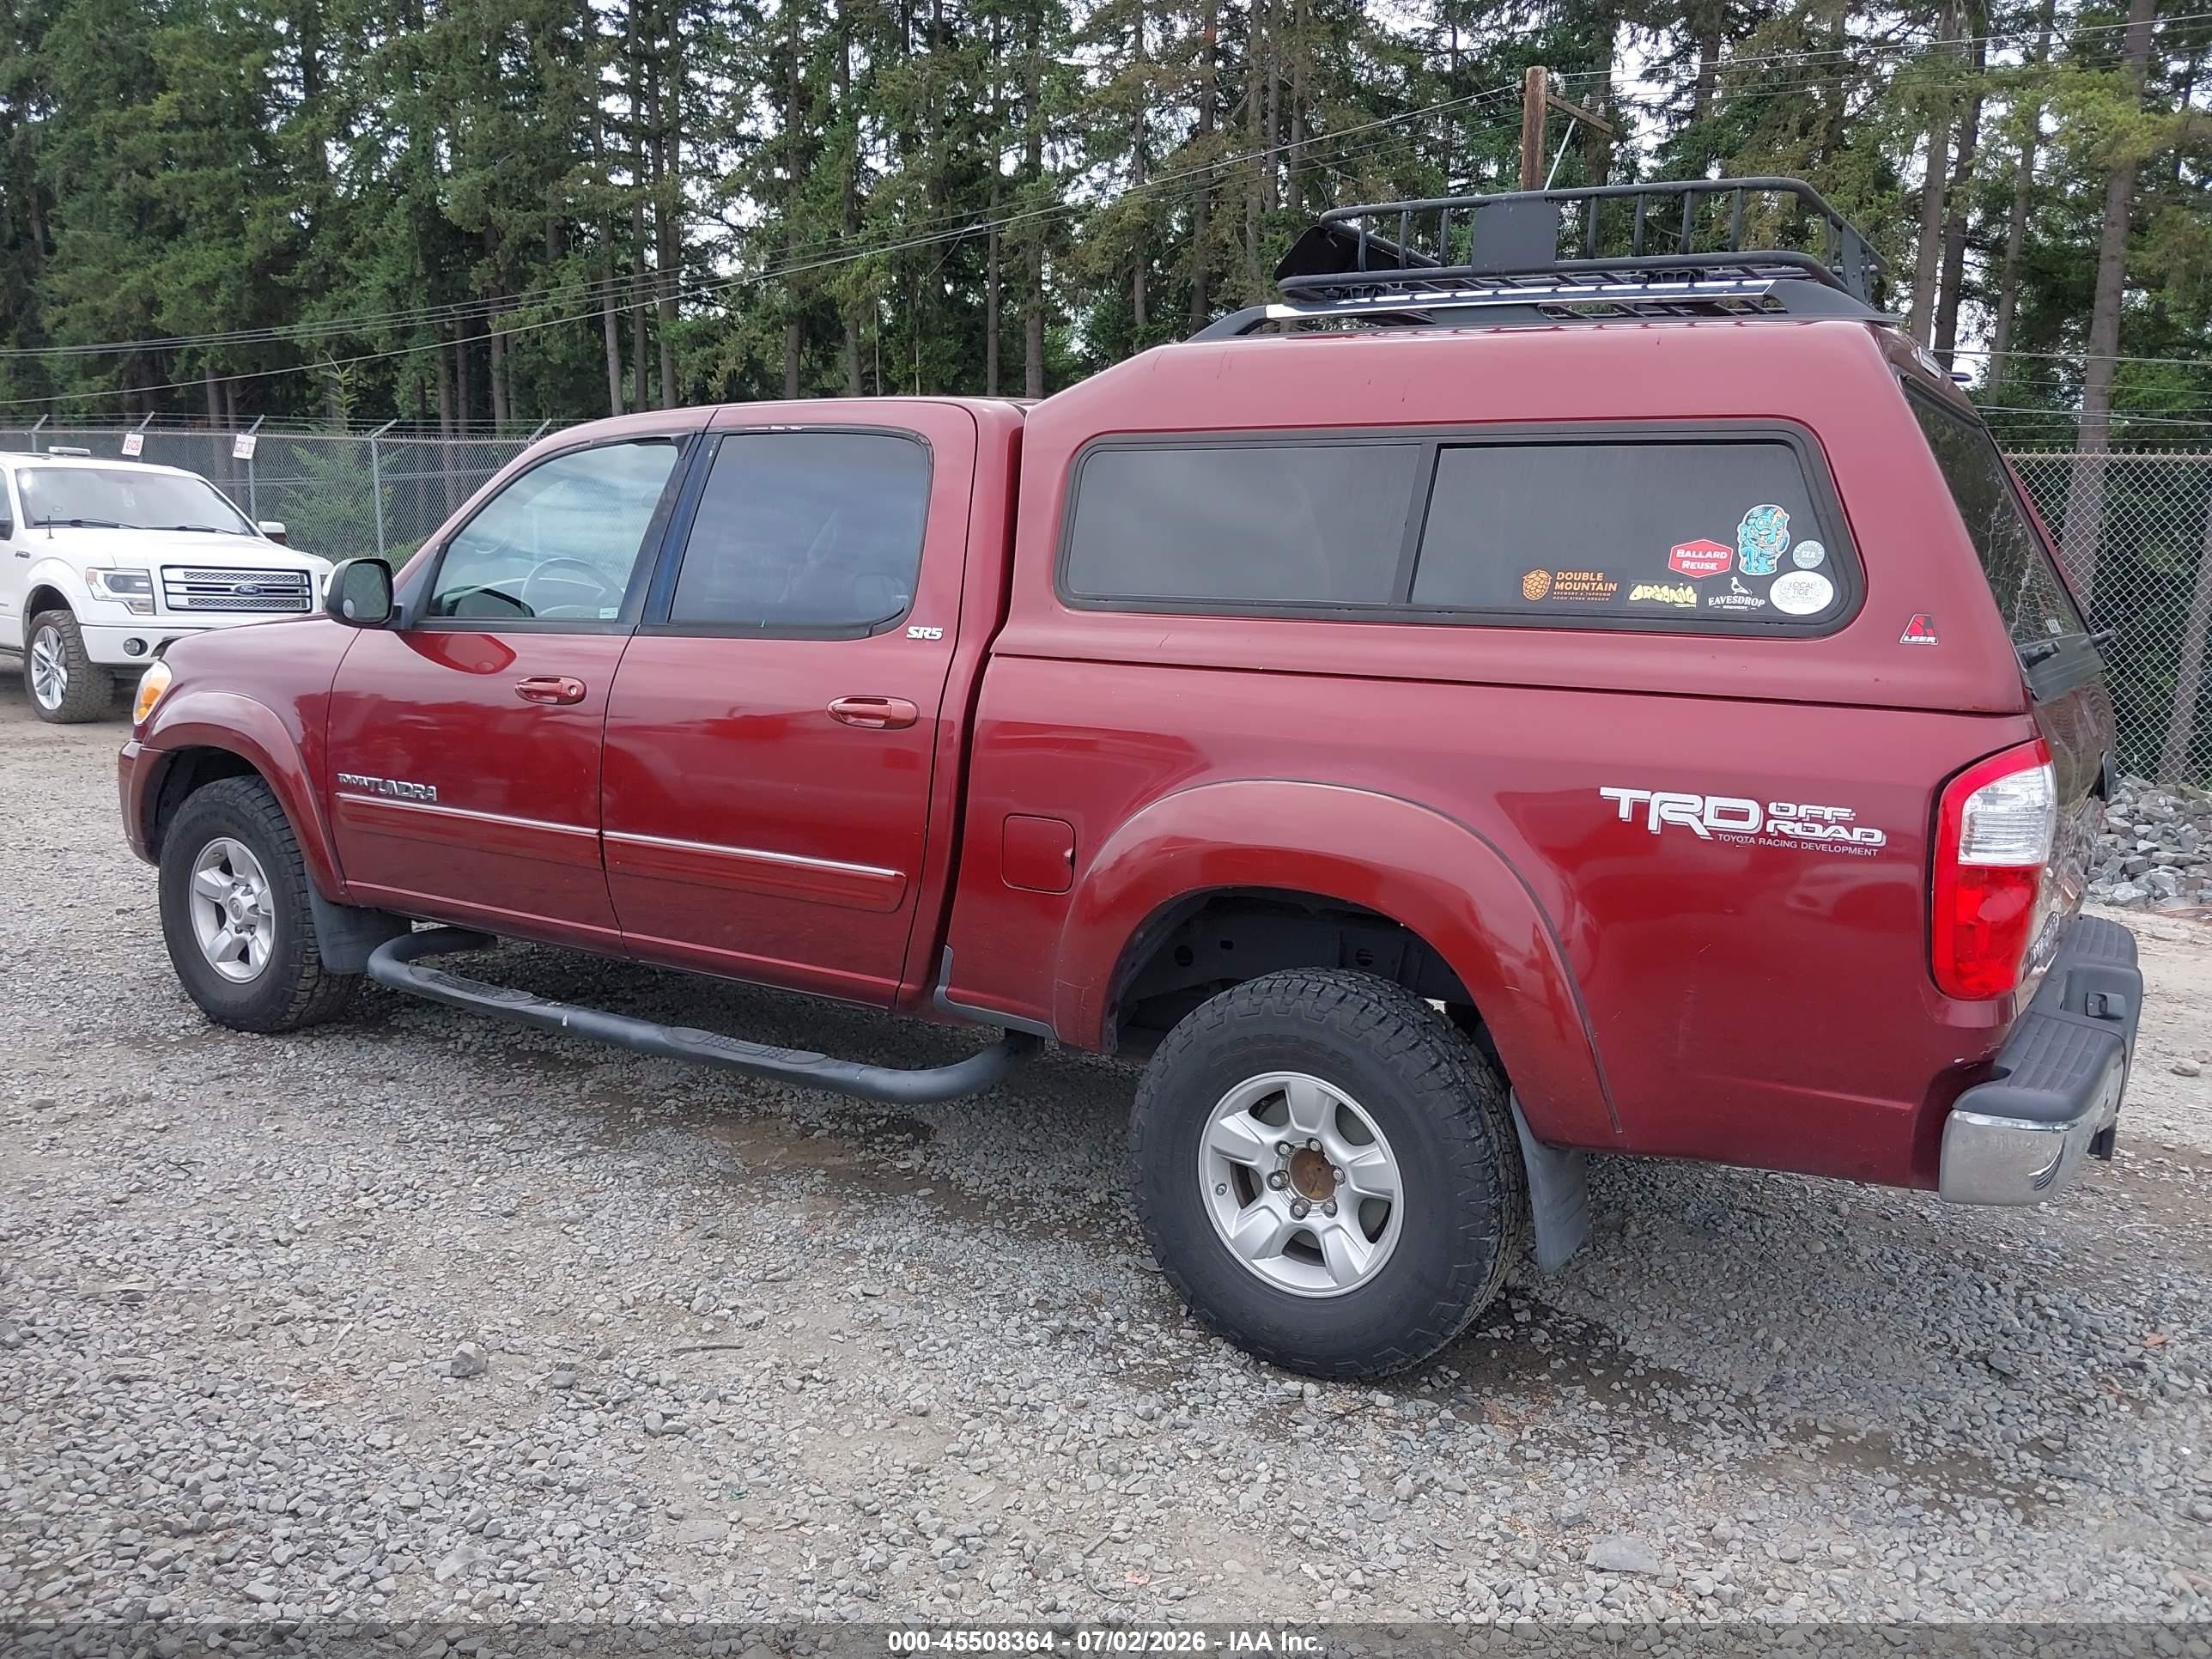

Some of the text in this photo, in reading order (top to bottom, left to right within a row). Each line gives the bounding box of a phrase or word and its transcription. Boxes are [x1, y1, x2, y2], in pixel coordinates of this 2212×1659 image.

[1676, 549, 1728, 559] BALLARD
[1681, 560, 1718, 571] REUSE
[1556, 571, 1604, 581] DOUBLE
[1554, 581, 1619, 592] MOUNTAIN
[1708, 595, 1766, 608] EAVESDROP
[906, 626, 944, 640] SR5
[367, 776, 438, 801] TUNDRA
[1600, 786, 1764, 840] TRD
[1767, 801, 1856, 823] OFF
[1766, 819, 1887, 847] ROAD
[1717, 833, 1879, 857] TOYOTA RACING DEVELOPMENT
